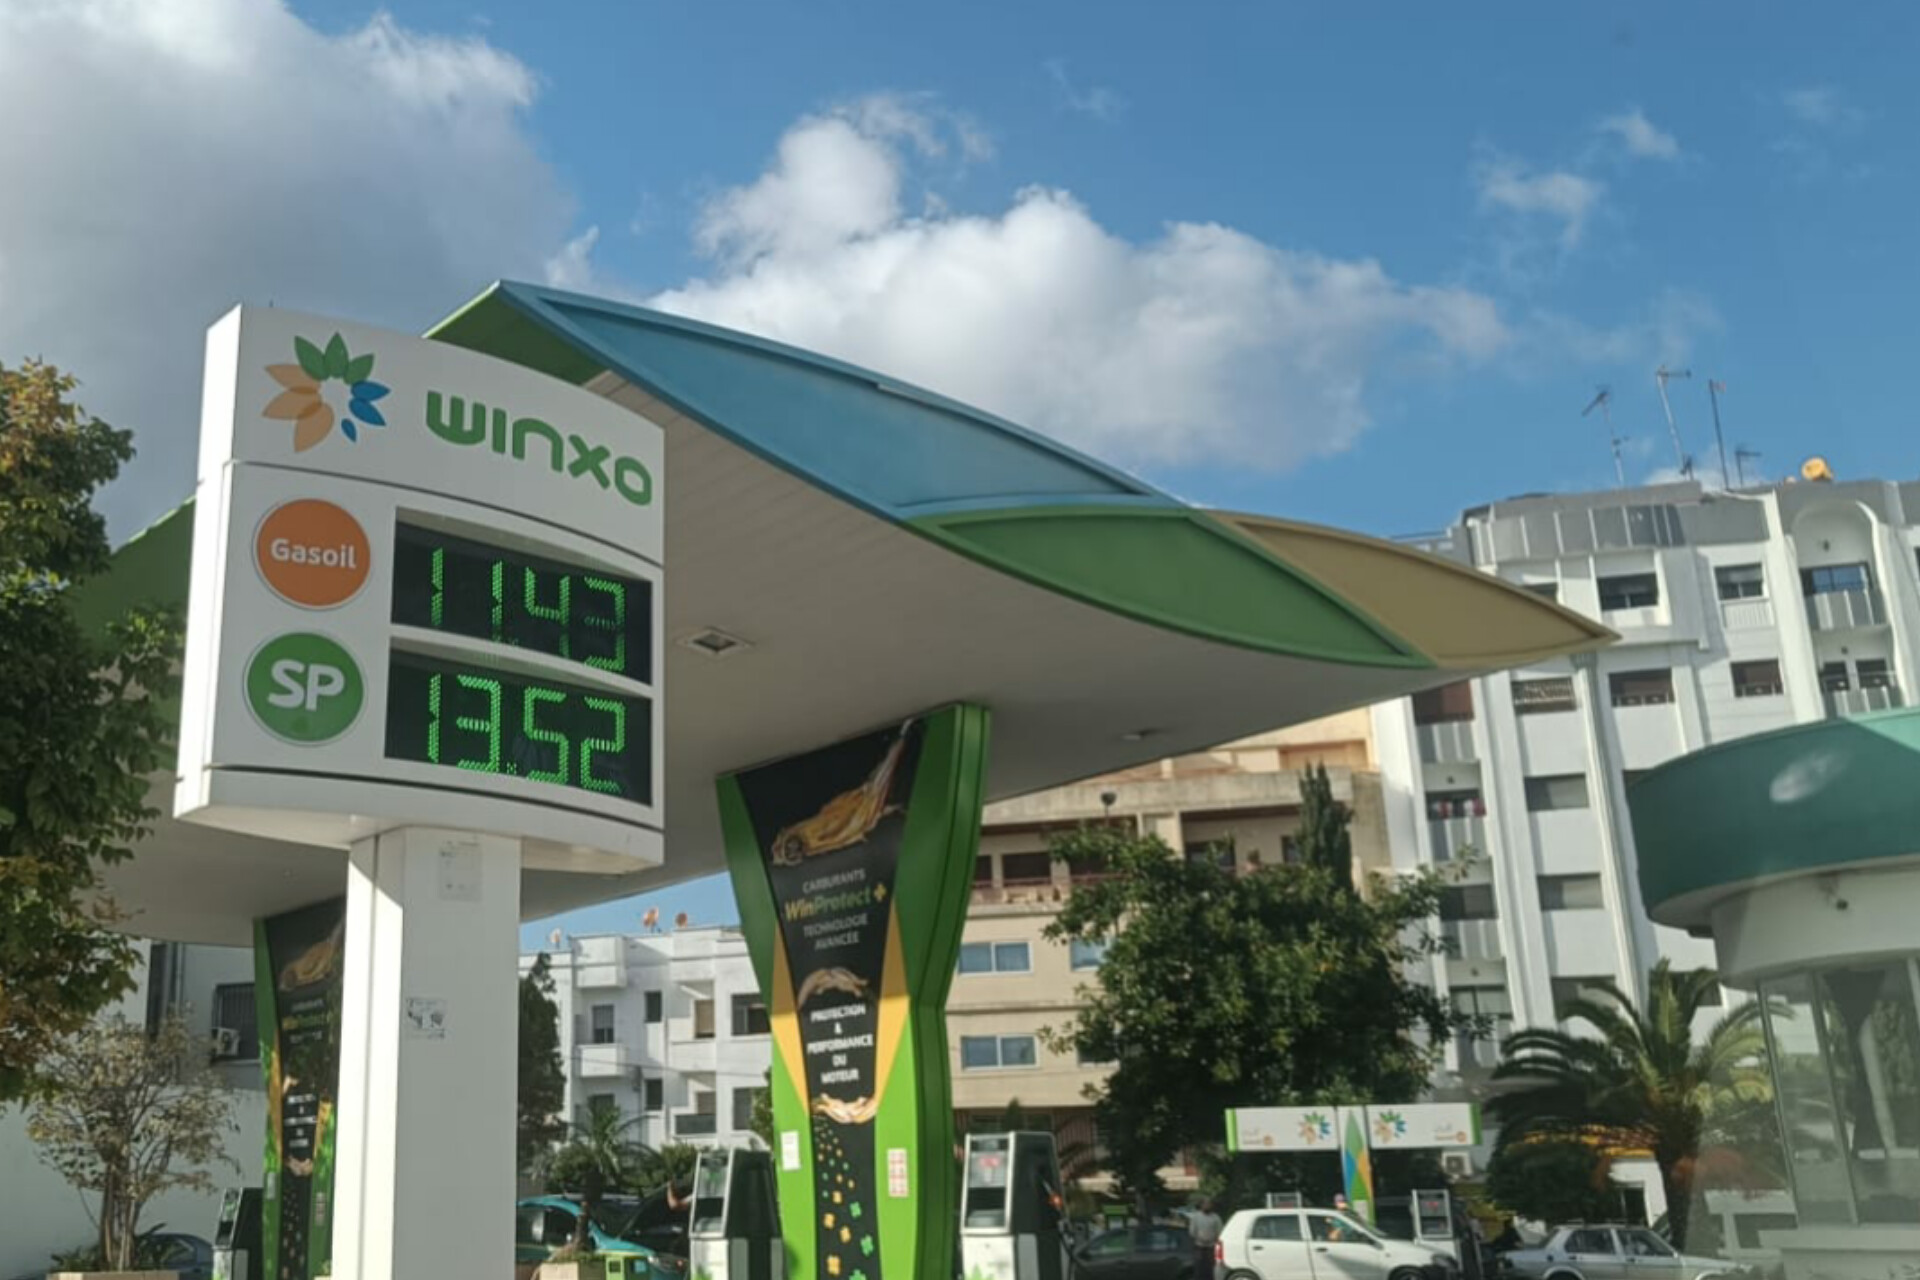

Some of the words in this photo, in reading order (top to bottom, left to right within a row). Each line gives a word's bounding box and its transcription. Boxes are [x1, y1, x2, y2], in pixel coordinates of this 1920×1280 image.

[271, 538, 356, 569] Gasoil
[267, 660, 345, 711] SP
[427, 674, 625, 792] 13.52
[811, 1004, 866, 1022] PROTECTION
[807, 1033, 873, 1054] PERFORMANCE
[821, 1068, 859, 1084] MOTEUR
